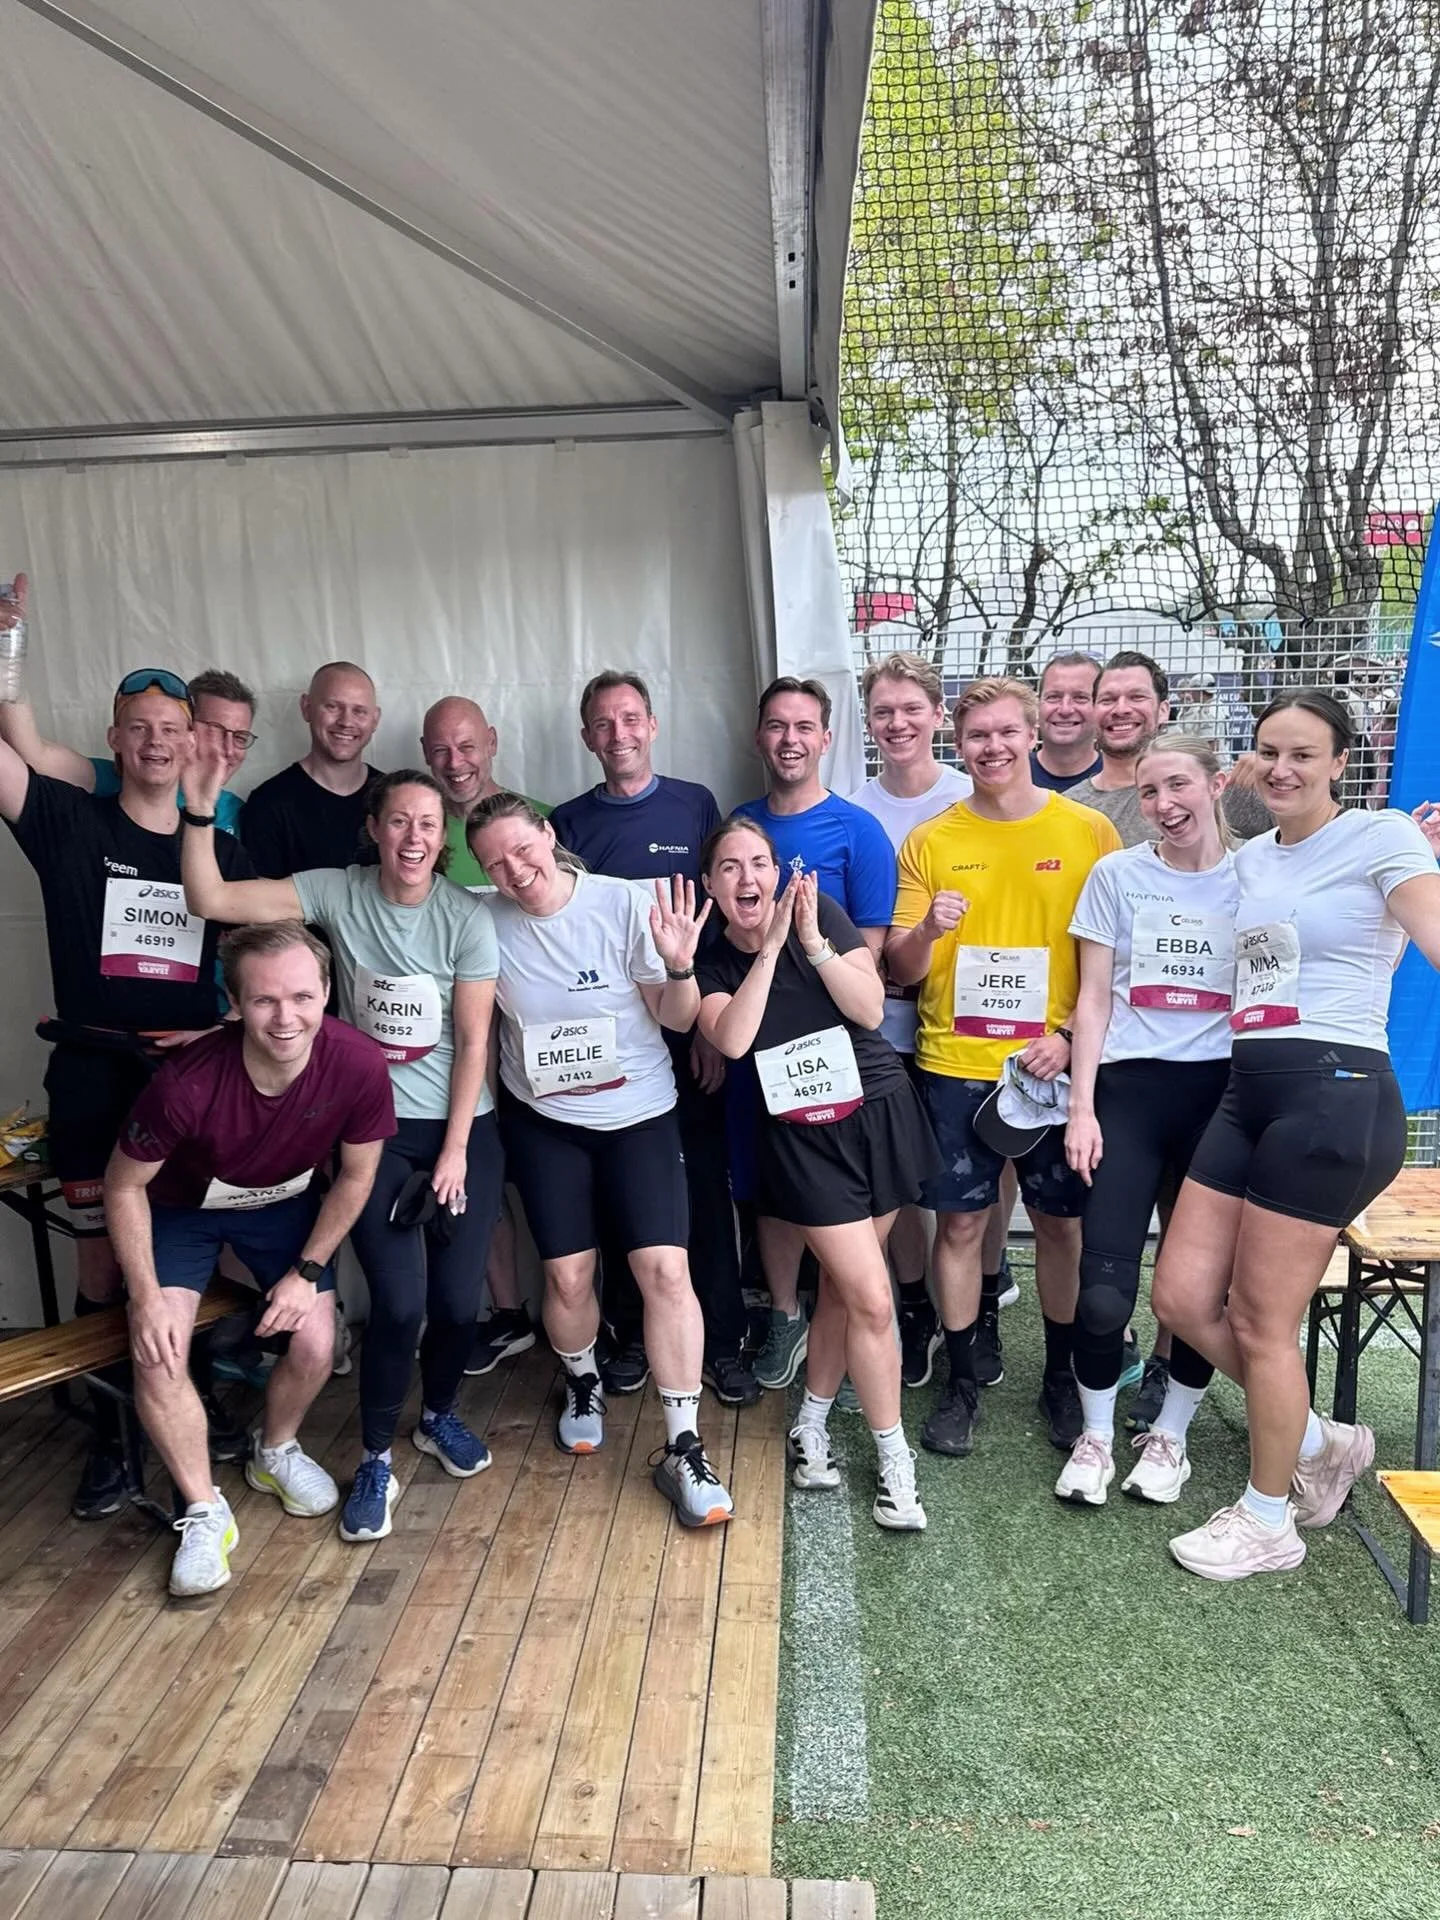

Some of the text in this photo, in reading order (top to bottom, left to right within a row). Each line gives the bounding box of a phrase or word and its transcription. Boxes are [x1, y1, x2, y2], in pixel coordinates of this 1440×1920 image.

[104, 856, 138, 877] reem
[152, 888, 180, 900] asics
[124, 907, 188, 928] SIMON
[135, 934, 175, 948] 46919
[1156, 938, 1213, 955] EBBA
[1161, 964, 1205, 977] 46934
[1250, 955, 1280, 975] NINA
[372, 980, 396, 992] stc
[978, 975, 1026, 989] JERE
[366, 996, 423, 1016] KARIN
[981, 998, 1021, 1009] 47507
[374, 1022, 413, 1036] 46952
[562, 1026, 588, 1036] asics
[796, 1037, 821, 1051] asics
[537, 1045, 603, 1066] EMELIE
[786, 1057, 829, 1078] LISA
[558, 1070, 593, 1083] 47412
[794, 1081, 832, 1098] 46972
[662, 1394, 700, 1408] ET'S
